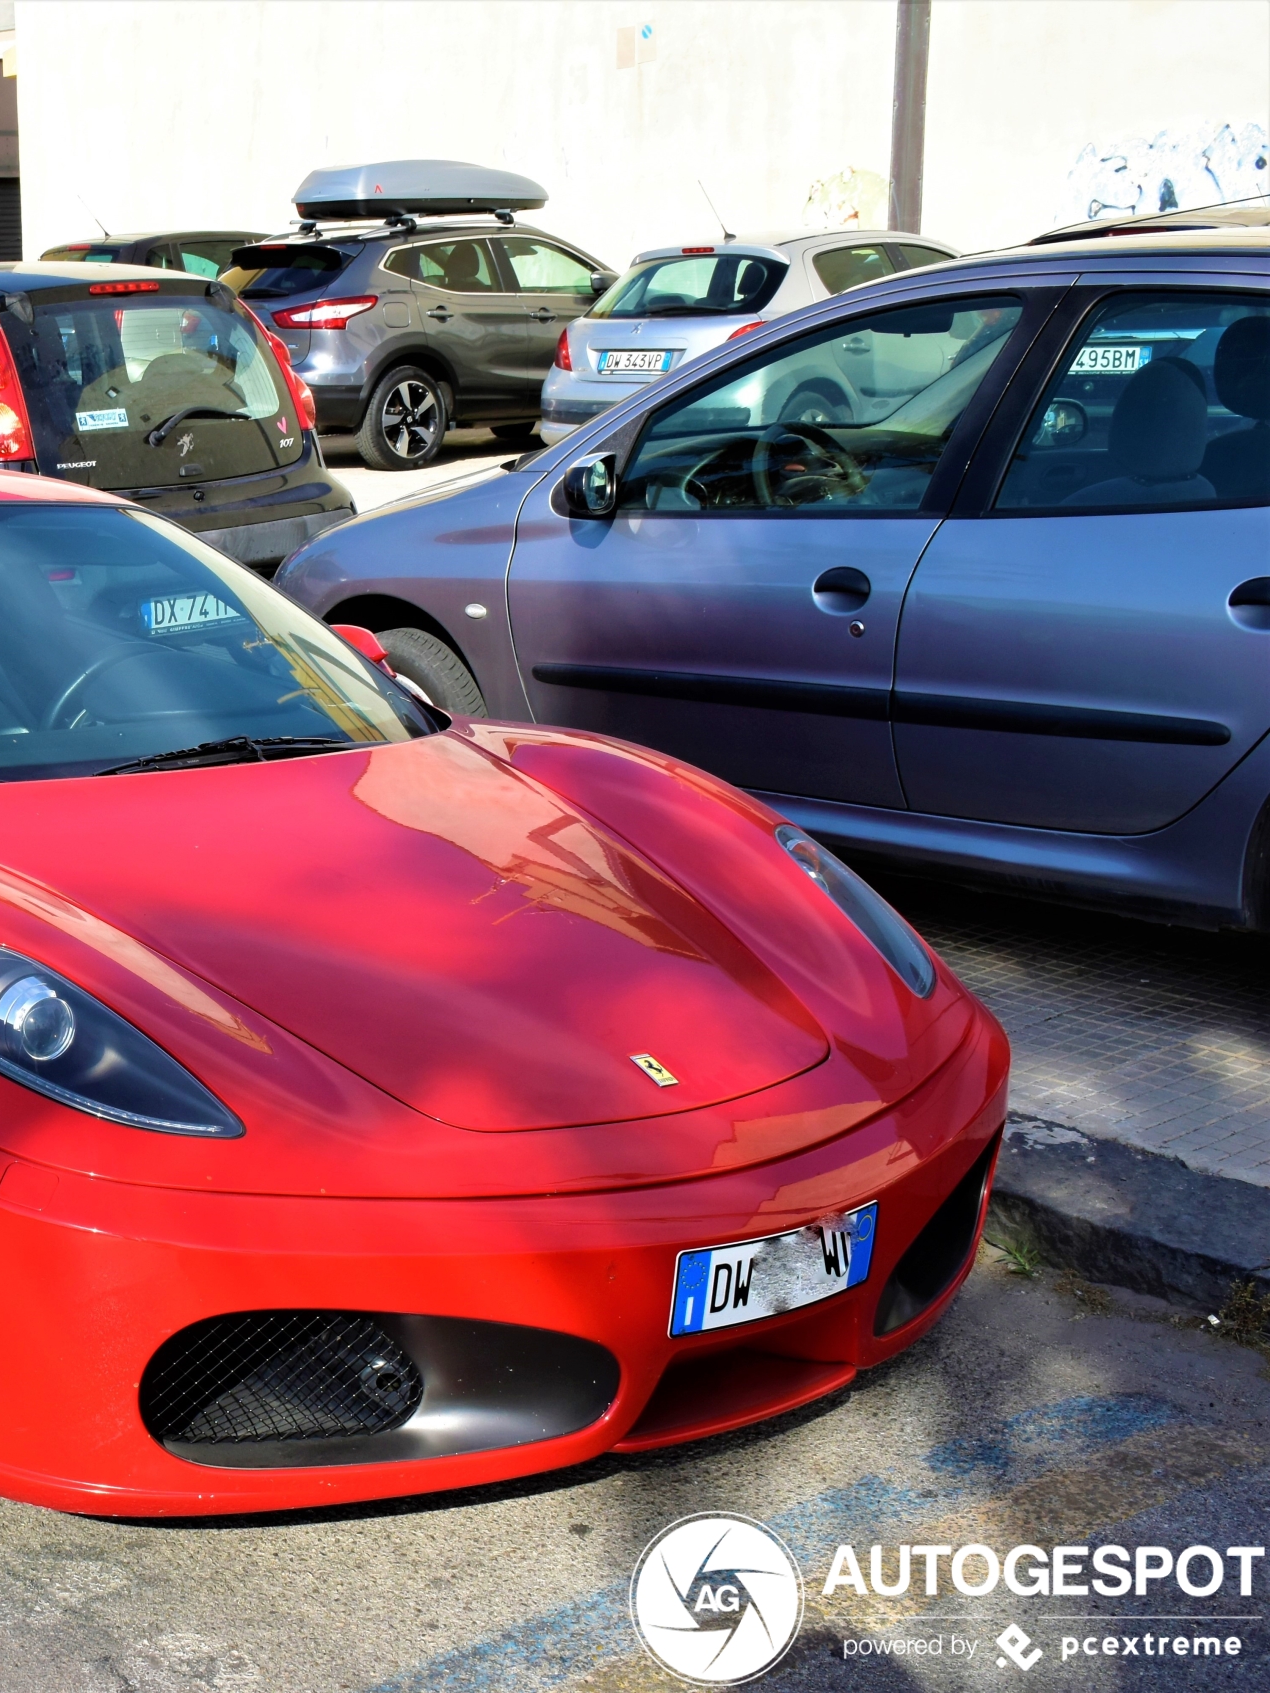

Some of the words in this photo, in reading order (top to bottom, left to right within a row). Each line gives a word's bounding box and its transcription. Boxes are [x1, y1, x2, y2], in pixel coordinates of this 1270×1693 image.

[606, 354, 622, 368] DW
[624, 354, 662, 368] 343VP
[279, 437, 294, 448] 107
[56, 460, 97, 470] PEUGEOT
[153, 597, 178, 626] DX
[710, 1257, 754, 1314] DW
